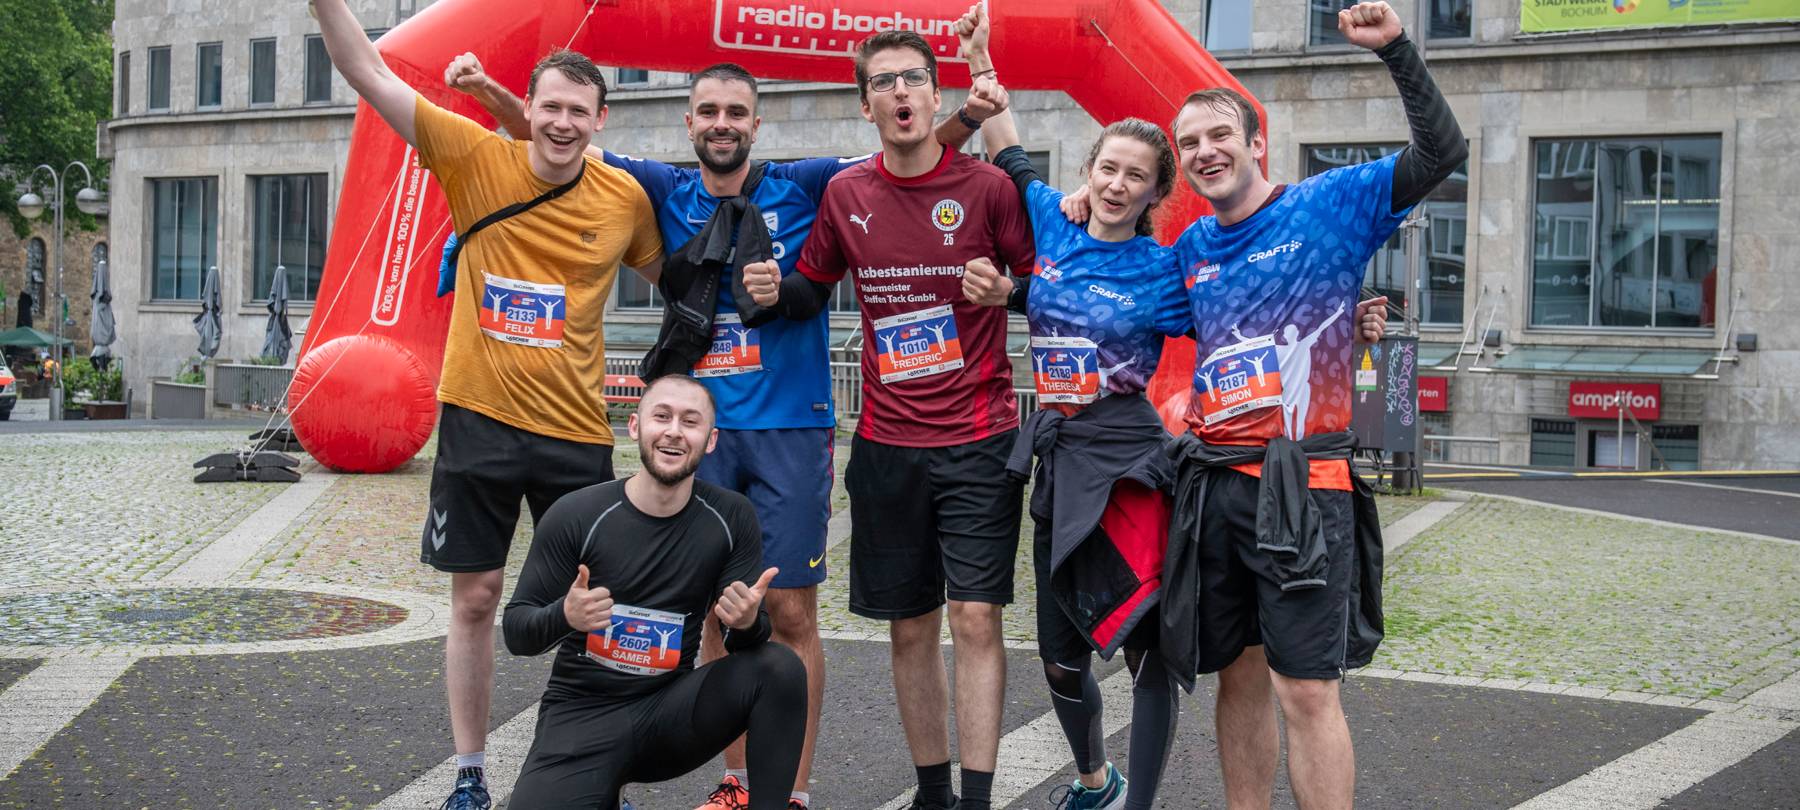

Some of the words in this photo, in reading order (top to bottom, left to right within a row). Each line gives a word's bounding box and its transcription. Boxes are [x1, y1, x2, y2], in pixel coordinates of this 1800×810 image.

[738, 5, 825, 29] radio
[1561, 6, 1607, 17] BOCHUM
[407, 169, 421, 196] beste
[405, 196, 415, 212] die
[397, 213, 411, 241] 100%
[392, 243, 405, 263] hier.
[1248, 244, 1289, 263] CRAFT
[391, 265, 400, 282] von
[858, 264, 964, 279] Asbestsanierung
[382, 284, 396, 313] 100%
[887, 294, 906, 303] Tack
[907, 293, 936, 302] GmbH
[1089, 284, 1125, 303] CRAFT
[507, 308, 536, 322] 2133
[505, 322, 535, 335] FELIX
[901, 340, 928, 355] 1010
[706, 356, 736, 366] LUKAS
[893, 352, 942, 369] FREDERIC
[1049, 367, 1071, 379] 2188
[1042, 381, 1081, 392] THERESA
[1219, 374, 1246, 392] 2187
[1221, 388, 1252, 406] SIMON
[1572, 390, 1656, 411] amplifon
[620, 637, 650, 651] 2602
[611, 649, 651, 665] SAMER
